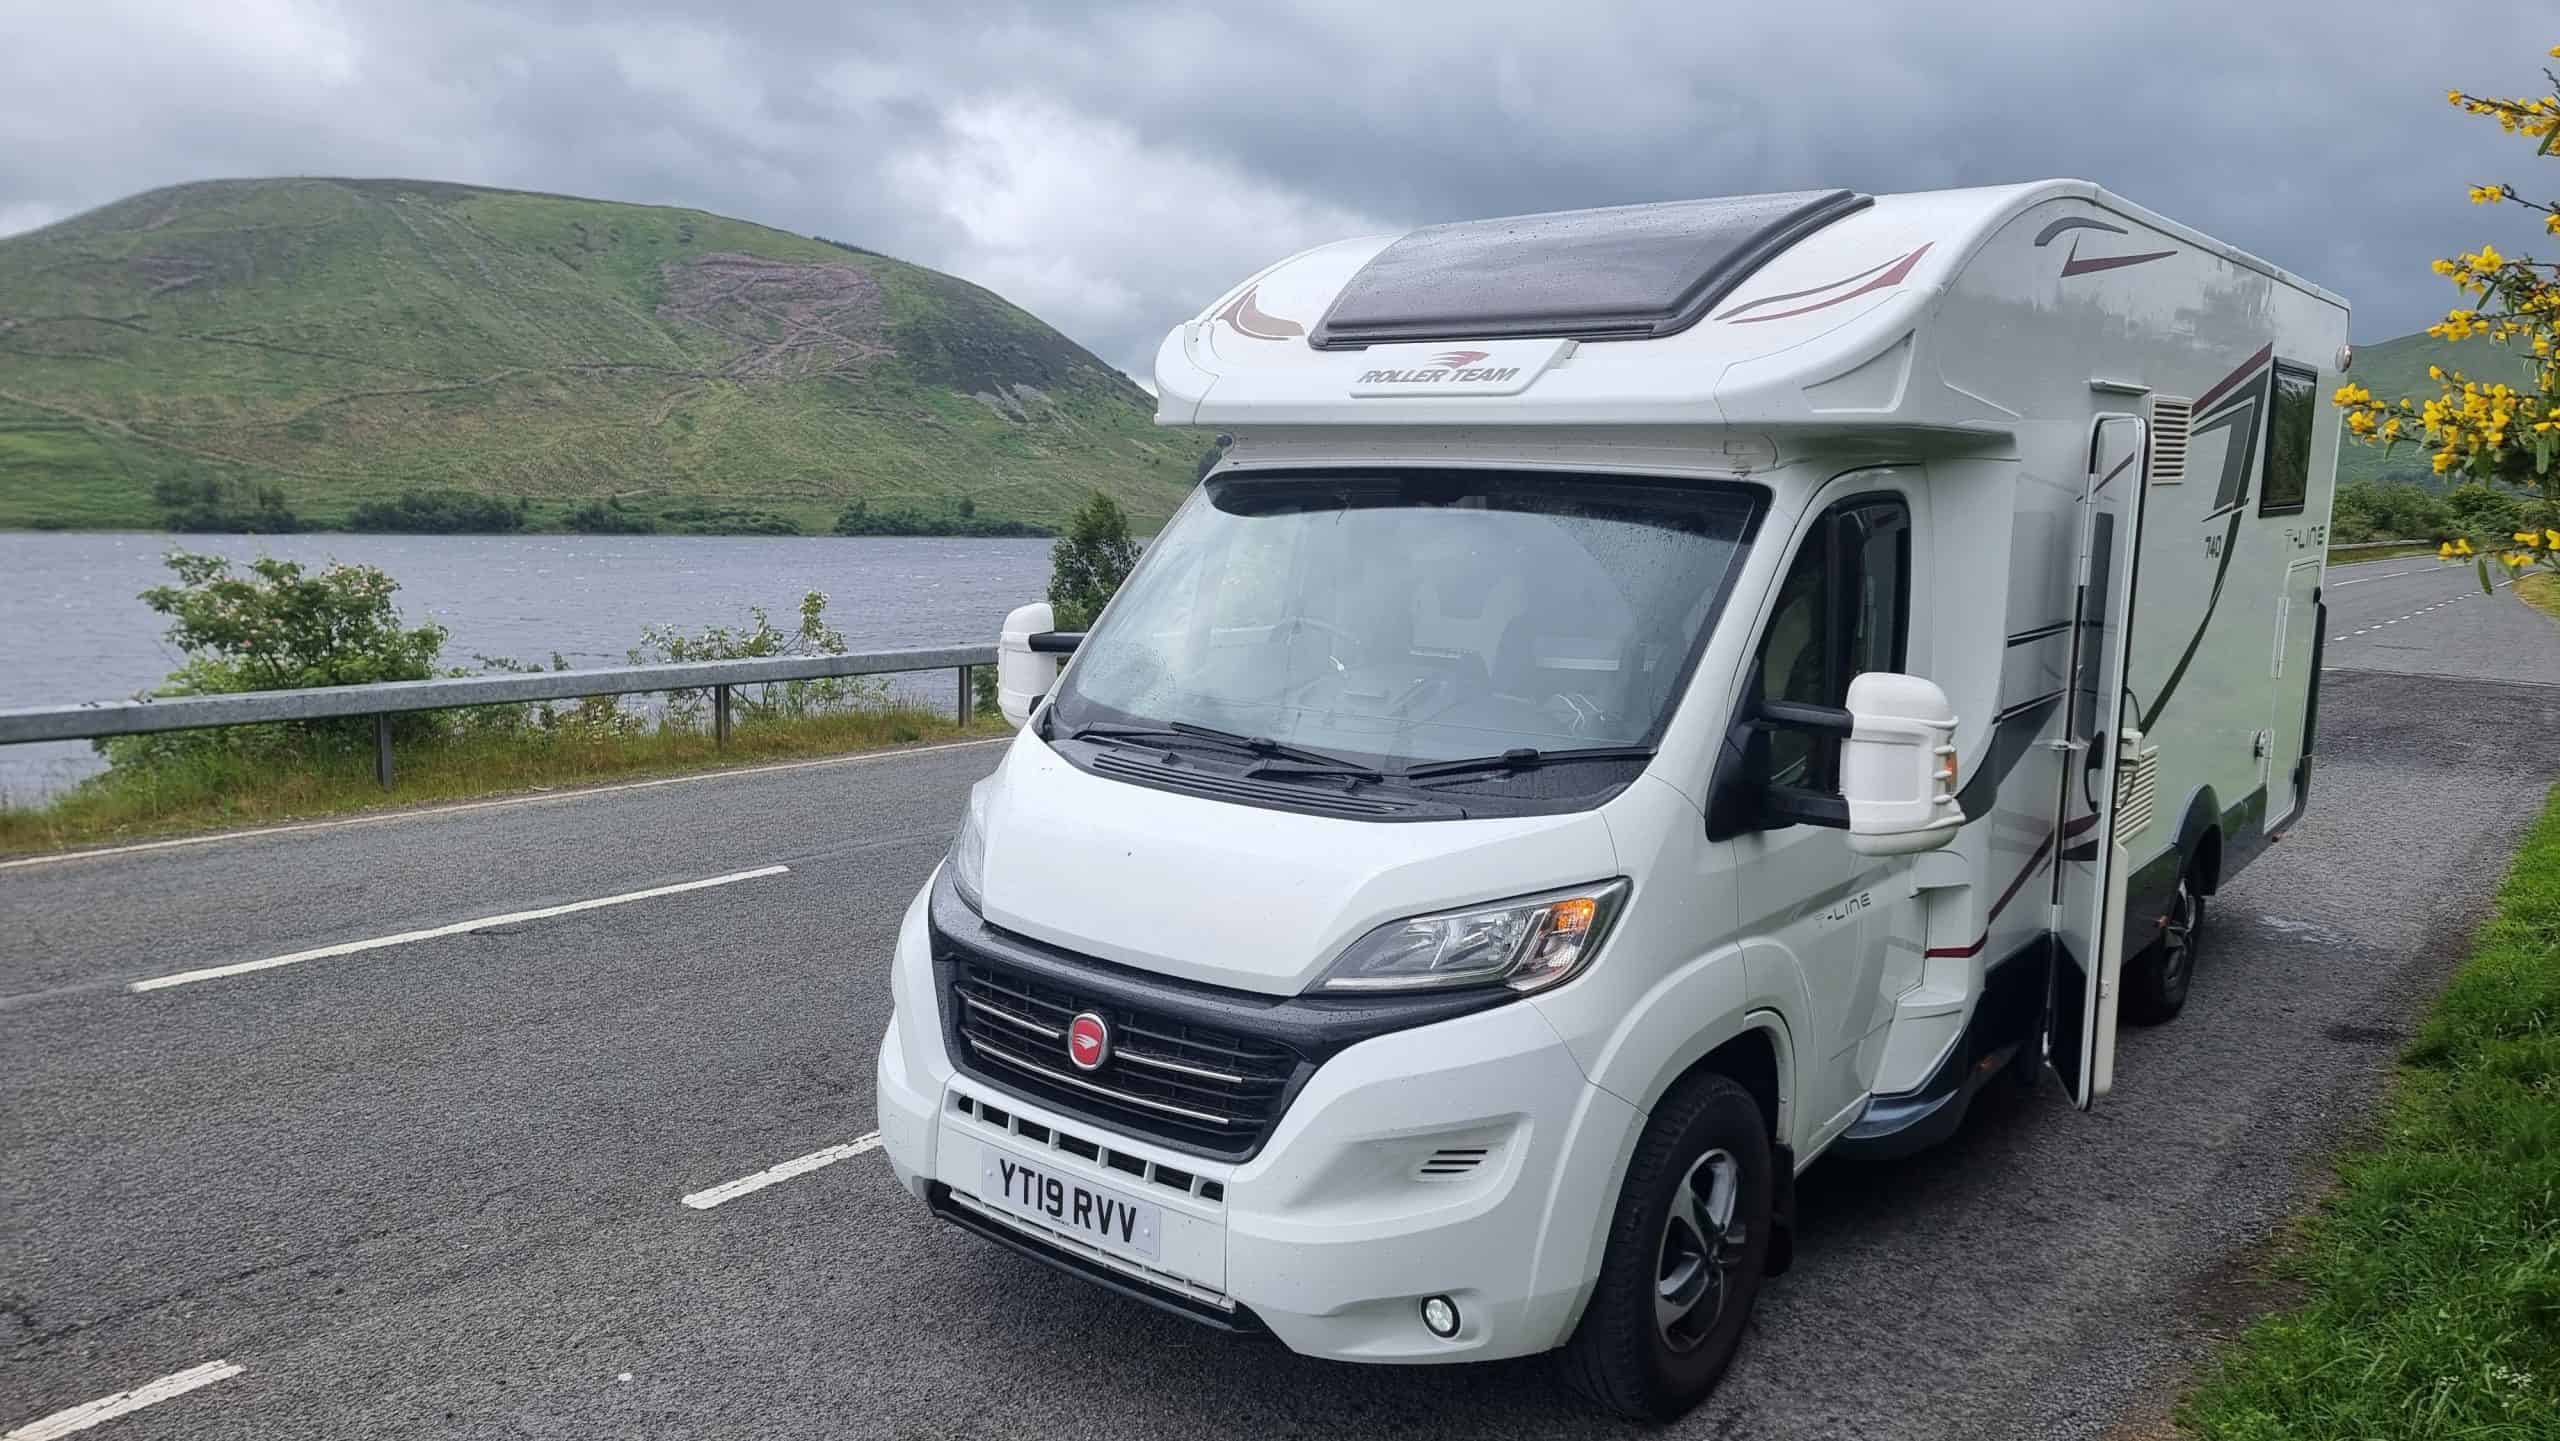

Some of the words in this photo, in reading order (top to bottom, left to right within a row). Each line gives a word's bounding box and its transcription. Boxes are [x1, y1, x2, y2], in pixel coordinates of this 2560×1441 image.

[1357, 369, 1450, 384] ROLLER
[1450, 367, 1520, 382] TEAM
[2205, 535, 2222, 559] 740
[1000, 1158, 1064, 1218] YT19
[1073, 1187, 1137, 1243] RVV
